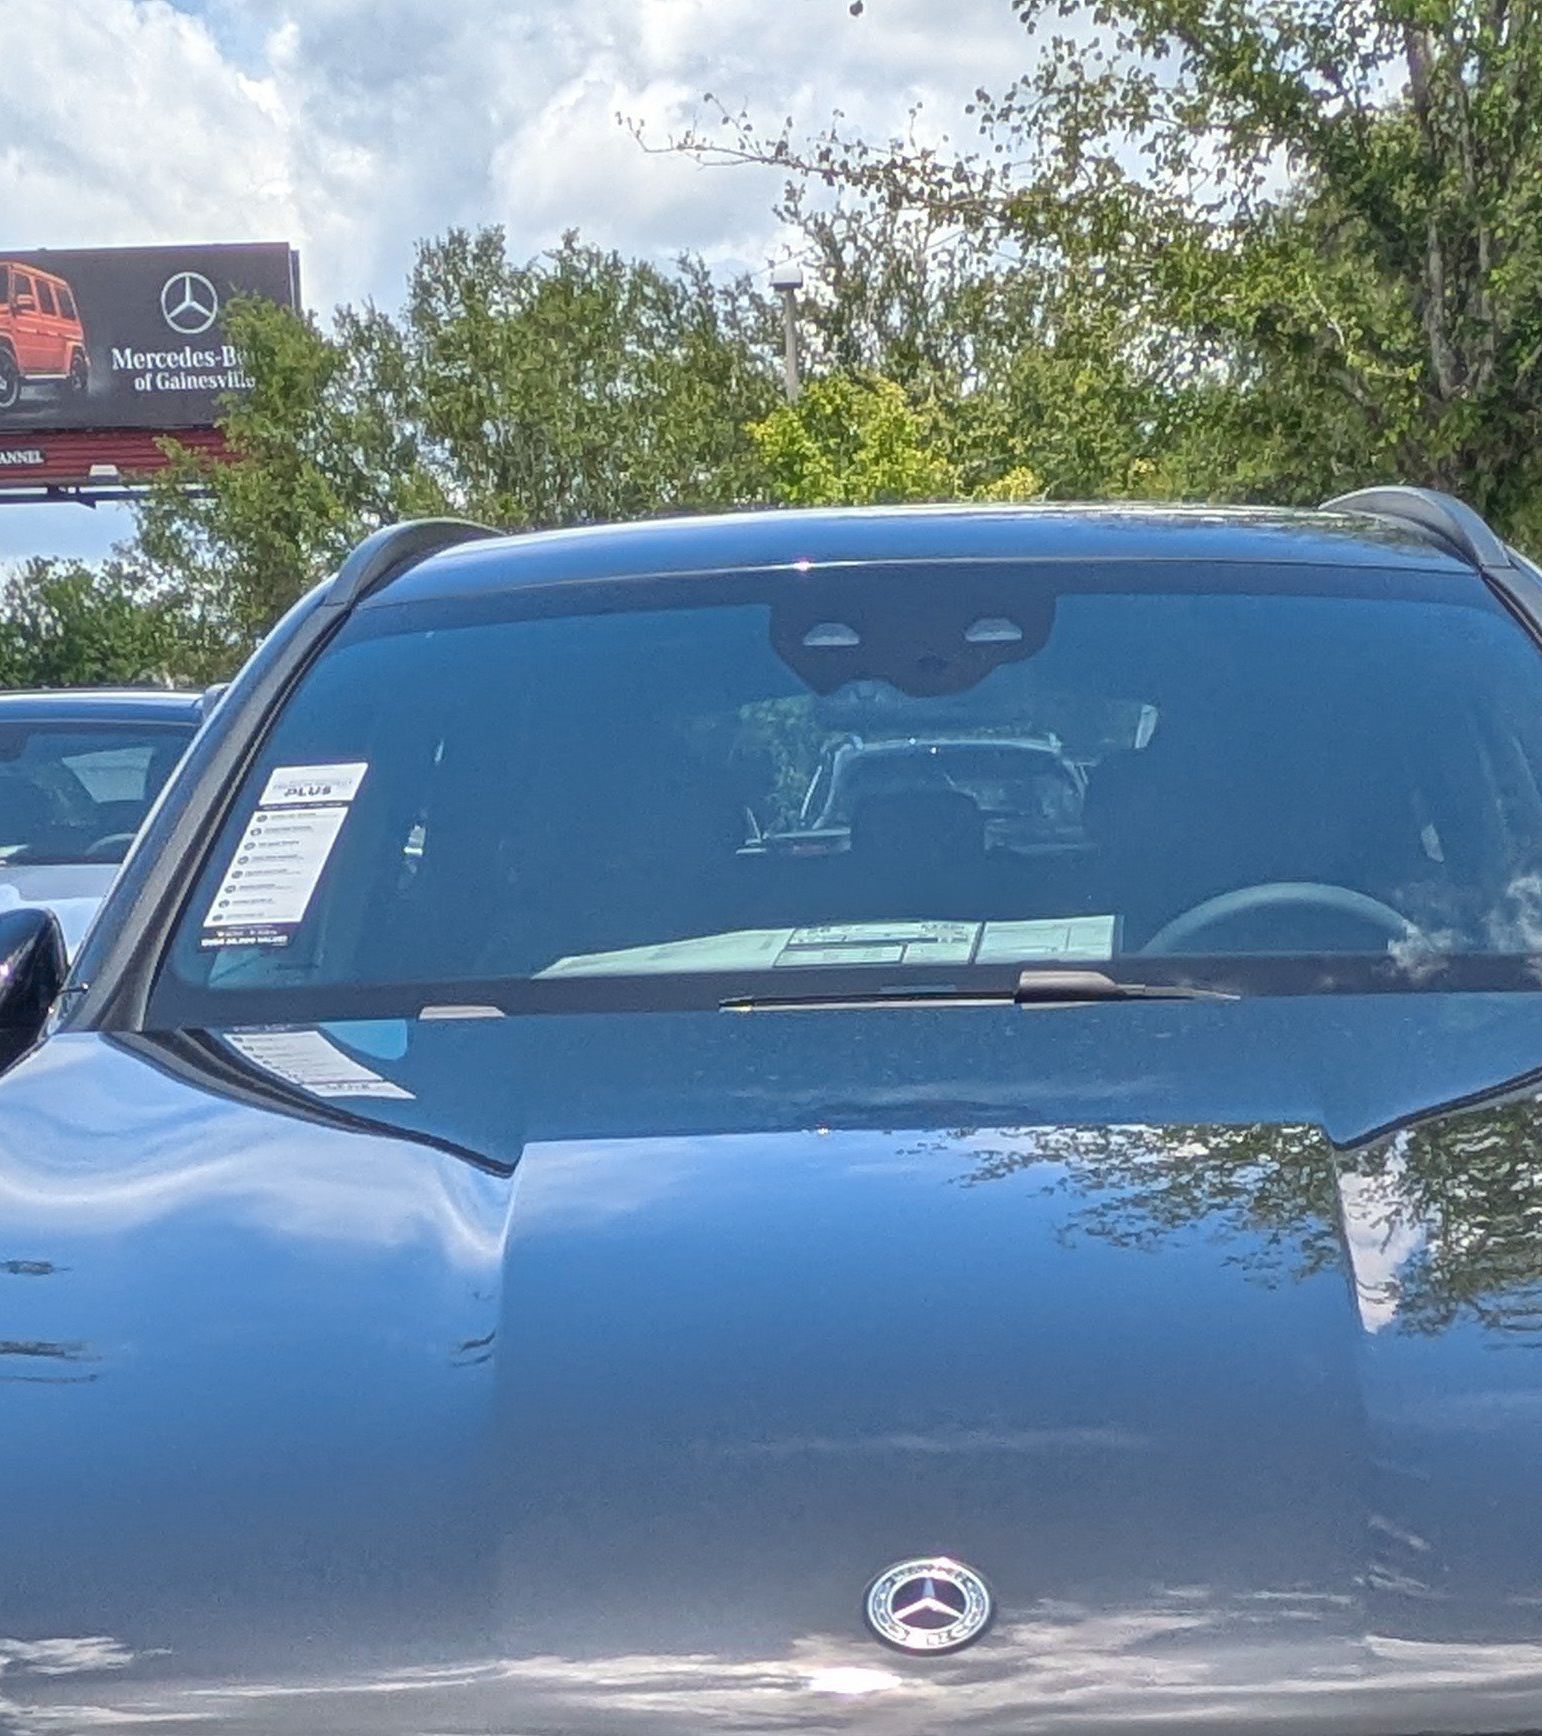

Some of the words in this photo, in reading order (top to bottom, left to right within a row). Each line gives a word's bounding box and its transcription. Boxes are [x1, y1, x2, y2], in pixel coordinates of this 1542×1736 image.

[110, 345, 254, 371] Mercedes-B
[133, 372, 154, 392] of
[155, 370, 257, 391] Gainesville
[283, 785, 332, 798] PLUS
